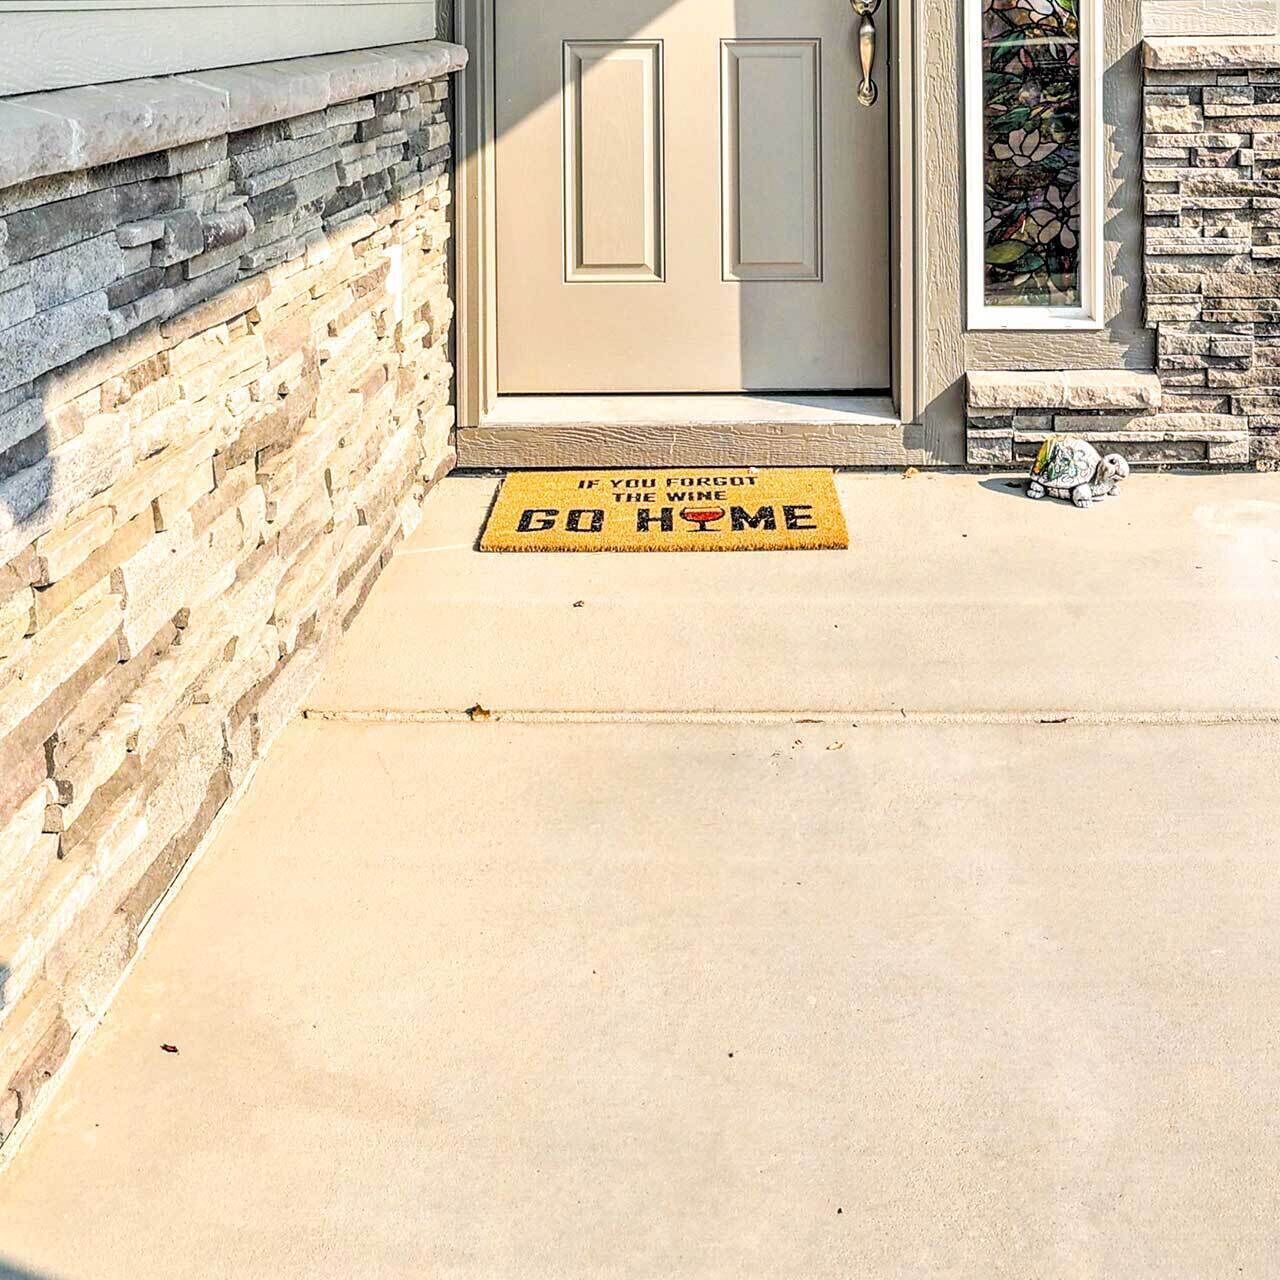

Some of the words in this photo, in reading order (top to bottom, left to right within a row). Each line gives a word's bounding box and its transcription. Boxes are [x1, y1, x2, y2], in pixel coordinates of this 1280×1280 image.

[578, 480, 599, 489] IF
[611, 478, 656, 488] YOU
[666, 476, 758, 487] FORGOT
[612, 491, 655, 503] THE
[666, 490, 727, 501] WINE
[515, 509, 604, 532] GO
